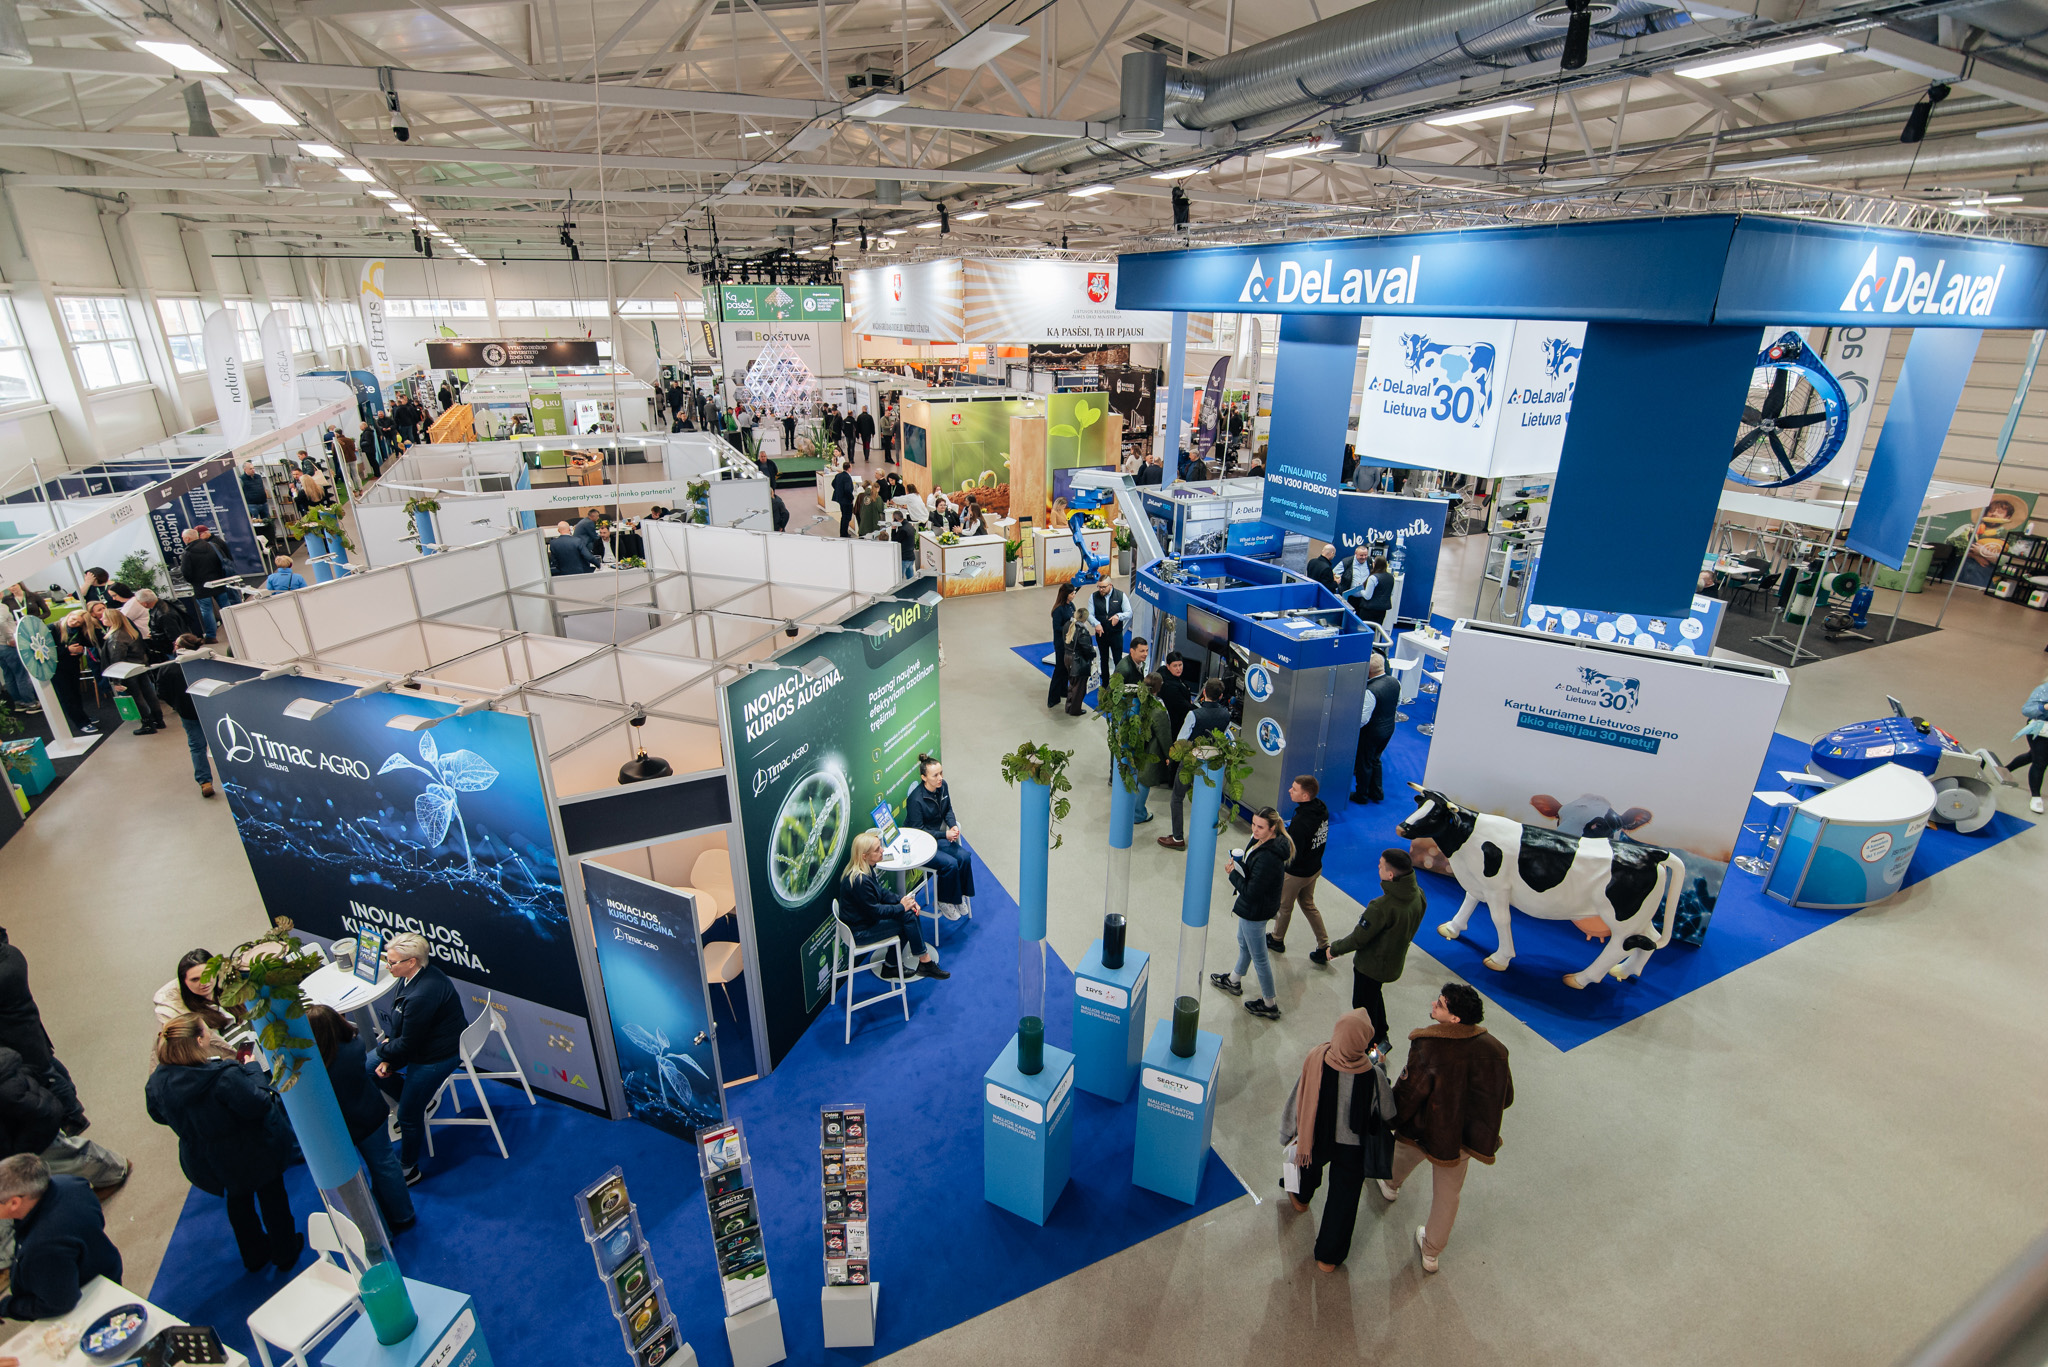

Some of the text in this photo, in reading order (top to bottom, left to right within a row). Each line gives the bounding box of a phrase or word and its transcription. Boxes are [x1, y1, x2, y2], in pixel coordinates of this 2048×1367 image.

[1277, 255, 1421, 304] DeLaval
[1882, 256, 2005, 316] DeLaval
[755, 331, 811, 341] BOKŠTUVA
[1047, 325, 1144, 339] KĄ PASĖSI, TĄ IR PJAUSI
[1383, 378, 1431, 397] DeLaval
[1522, 388, 1567, 404] DeLaval
[1383, 400, 1427, 418] Lietuva
[1521, 412, 1561, 427] Lietuva
[1812, 415, 1839, 467] DeLaval
[1279, 464, 1328, 483] ATNAUJINTAS
[1267, 473, 1338, 498] VMS V300 ROBOTAS
[116, 504, 133, 519] KREDA
[1243, 506, 1262, 515] DeLav
[56, 531, 79, 550] KREDA
[153, 514, 173, 552] staklės
[165, 513, 187, 560] Ukmerg
[1342, 518, 1432, 547] We live milk
[1142, 586, 1159, 600] DeLaval
[868, 658, 921, 704] Pažangi naujovė
[906, 663, 935, 692] azotiniam
[1565, 684, 1599, 697] DeLaval
[1565, 694, 1597, 706] Lietuva
[745, 668, 845, 741] KURIOS AUGINA.
[1504, 698, 1679, 741] Kartu kuriame Lietuvos pieno
[1520, 714, 1655, 750] ūkio ateitį jau 30 metų!
[250, 731, 371, 780] Timac AGRO
[767, 742, 809, 780] Timac AGRO
[263, 759, 290, 772] Lietuva
[606, 898, 661, 925] INOVACIJOS,
[349, 900, 470, 952] INOVACIJOS,
[608, 908, 677, 938] KURIOS AUGINA.
[624, 932, 660, 951] Timac AGRO
[1085, 986, 1103, 996] IRYS
[1080, 1004, 1121, 1020] NAUJOS KARTOS
[1080, 1009, 1121, 1024] BIOSTIMULIANTAI
[534, 1060, 590, 1090] DNA
[1157, 1076, 1189, 1090] SEACTIV
[999, 1093, 1030, 1109] SEACTIV
[1147, 1098, 1194, 1117] NAUJOS KARTOS
[1147, 1102, 1194, 1121] BIOSTIMULIANTAI
[992, 1113, 1036, 1136] NAUJOS KARTOS
[992, 1118, 1036, 1141] BIOSTIMULIANTAI
